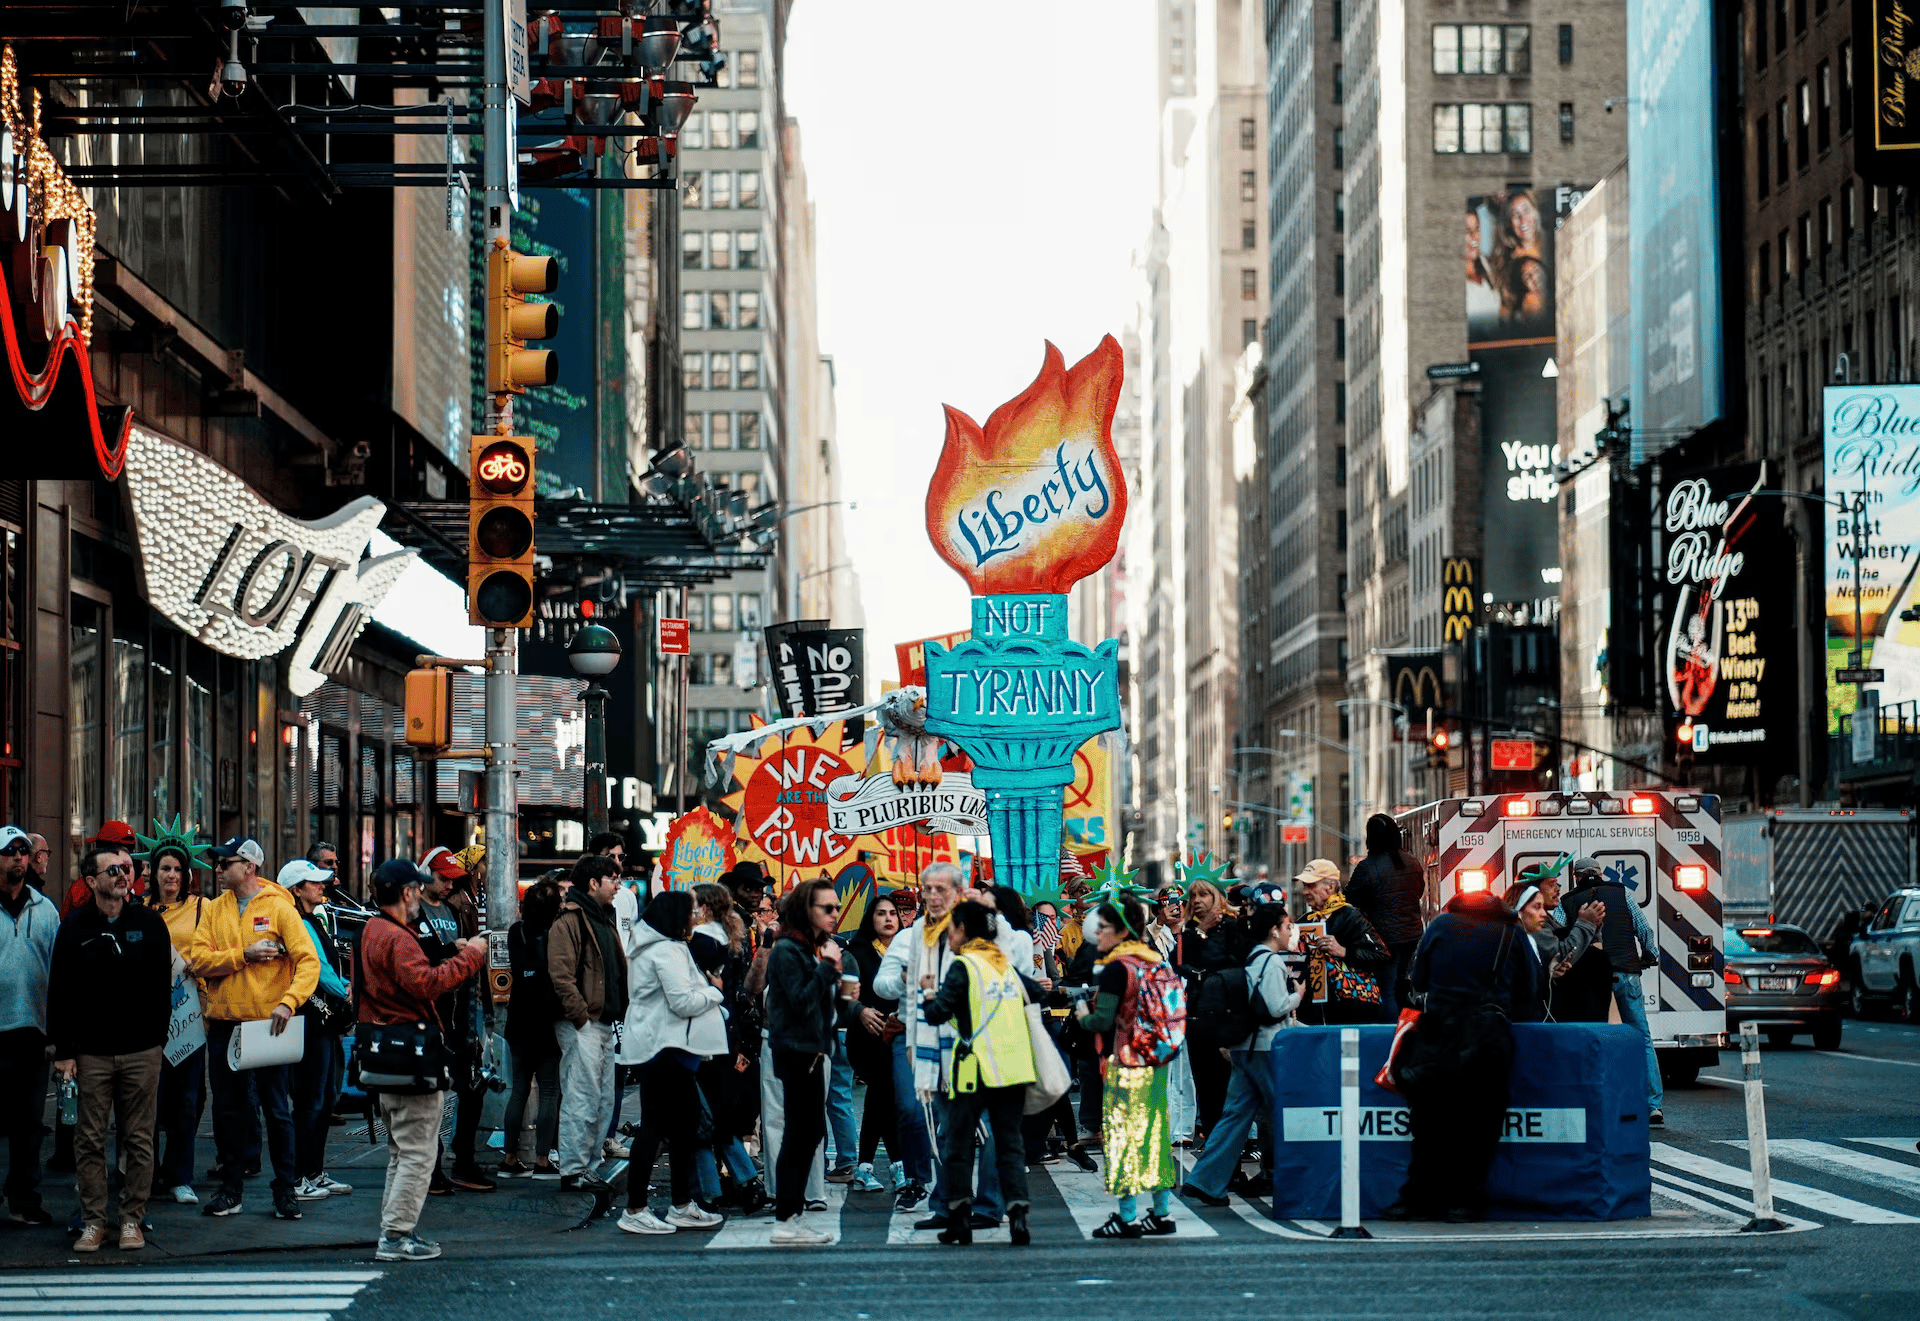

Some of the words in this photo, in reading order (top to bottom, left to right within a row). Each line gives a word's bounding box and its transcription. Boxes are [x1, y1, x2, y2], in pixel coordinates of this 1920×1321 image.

[1881, 72, 1906, 127] Blue
[1501, 441, 1549, 471] You
[958, 441, 1109, 568] Liberty
[1666, 478, 1729, 532] Blue
[1667, 531, 1744, 600] Ridge
[667, 622, 685, 630] STANDING
[985, 600, 1050, 636] NOT
[1725, 597, 1759, 632] 13th
[661, 630, 677, 638] Anytime
[1728, 631, 1757, 656] Best
[807, 643, 852, 672] NO
[1720, 656, 1766, 682] Winery
[940, 669, 1105, 716] TYRANNY
[1729, 682, 1739, 700] In
[1740, 681, 1757, 699] The
[1726, 699, 1761, 719] Nation!
[764, 749, 840, 790] WE
[776, 791, 803, 803] ARE
[833, 812, 847, 829] E
[855, 794, 954, 827] PLURIBUS
[753, 805, 853, 864] POWE
[1460, 835, 1484, 846] 1958
[1506, 829, 1562, 840] EMERGENCY
[1566, 828, 1607, 839] MEDICAL
[1610, 827, 1654, 838] SERVICES
[1677, 831, 1700, 842] 1958
[672, 837, 725, 870] Liberty
[693, 864, 725, 878] NOT
[1323, 1110, 1412, 1137] TMES
